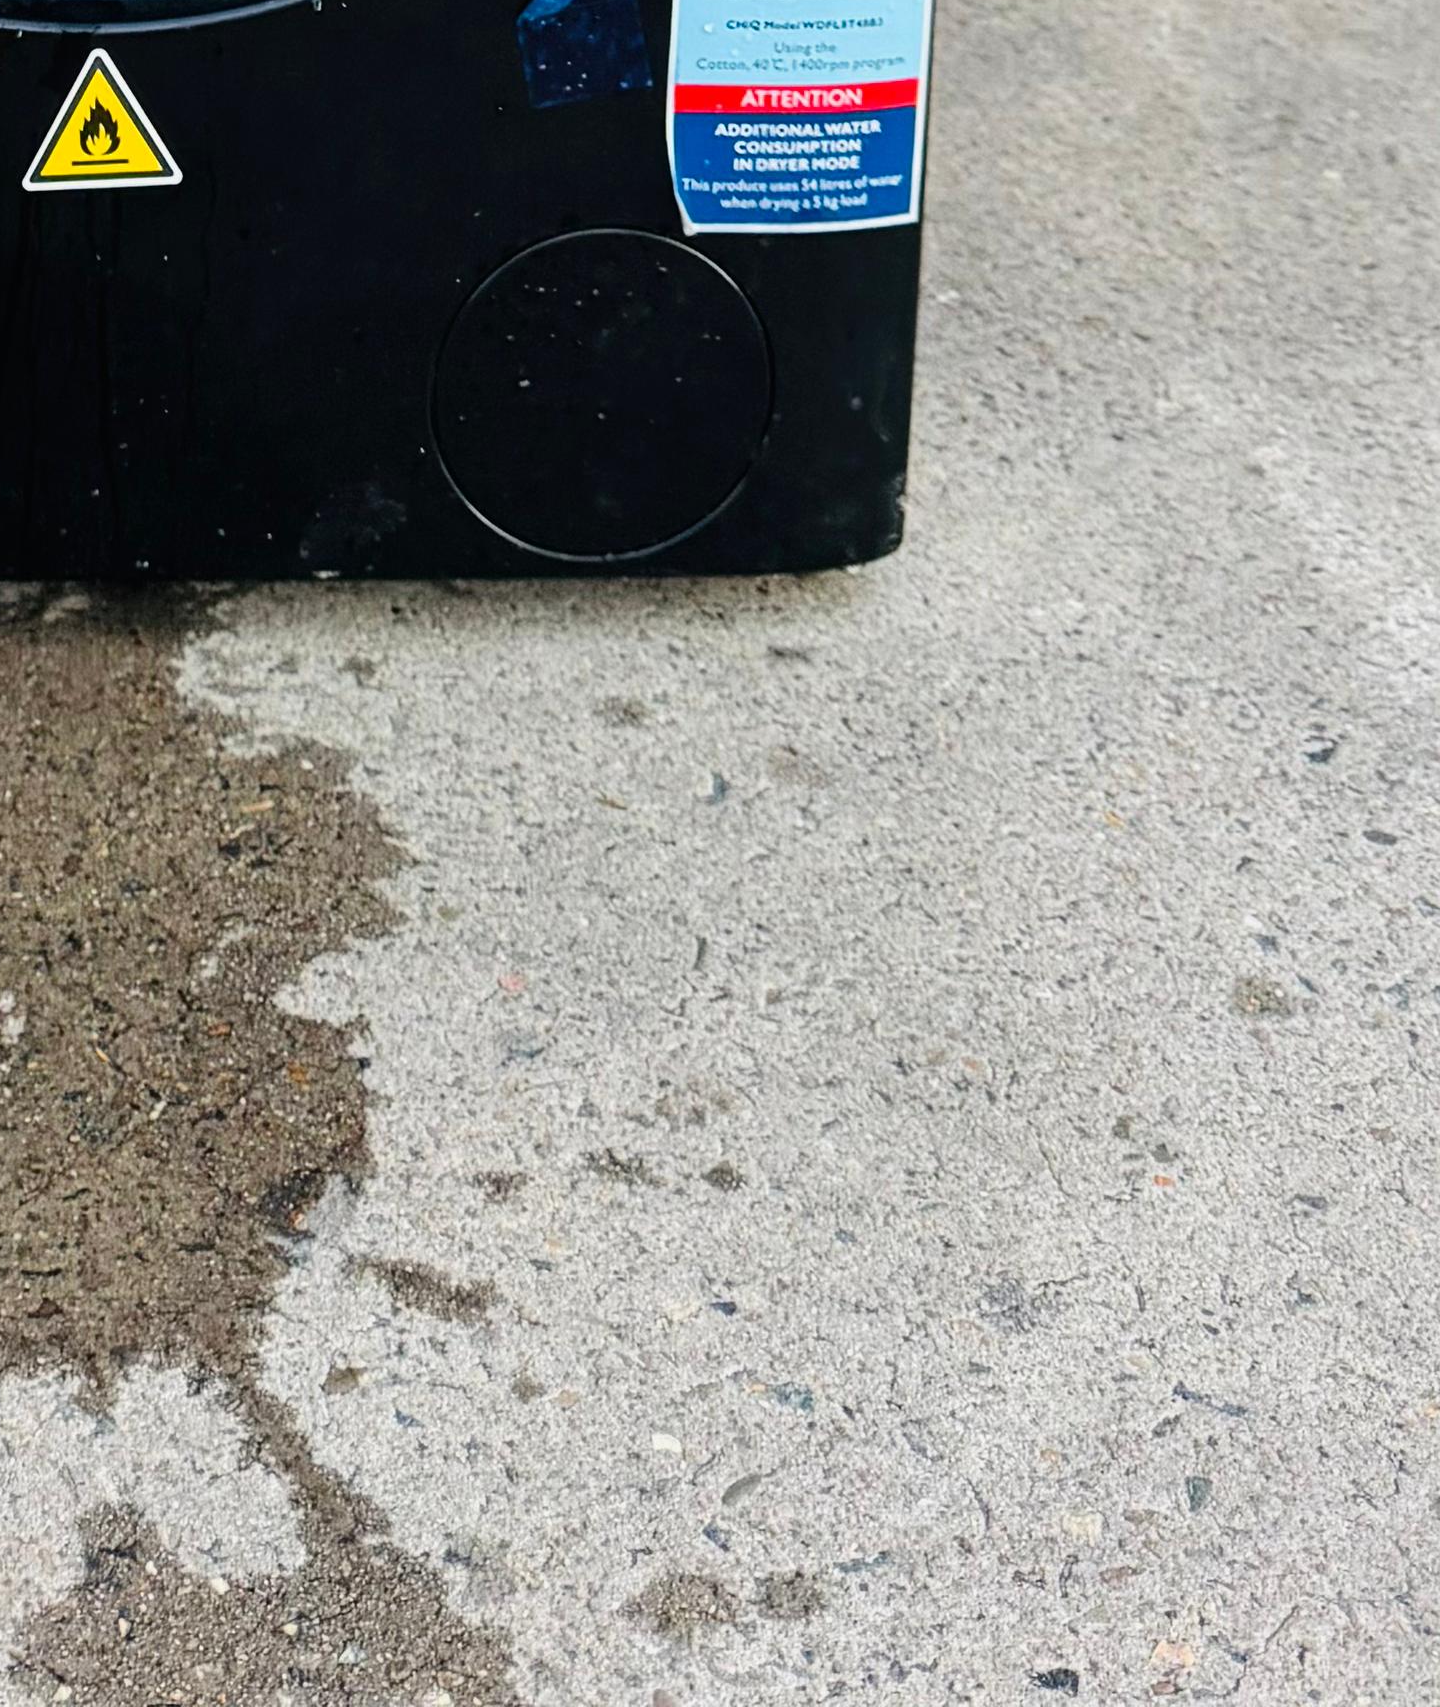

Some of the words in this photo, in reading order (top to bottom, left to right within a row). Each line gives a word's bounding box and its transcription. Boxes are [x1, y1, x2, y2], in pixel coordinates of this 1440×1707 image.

[740, 89, 863, 108] ATTENTION
[714, 122, 824, 137] ADDITIONAL
[824, 119, 882, 135] WATER
[733, 139, 862, 154] CONSUMPTION
[733, 157, 754, 172] IN
[755, 158, 810, 172] DRYER
